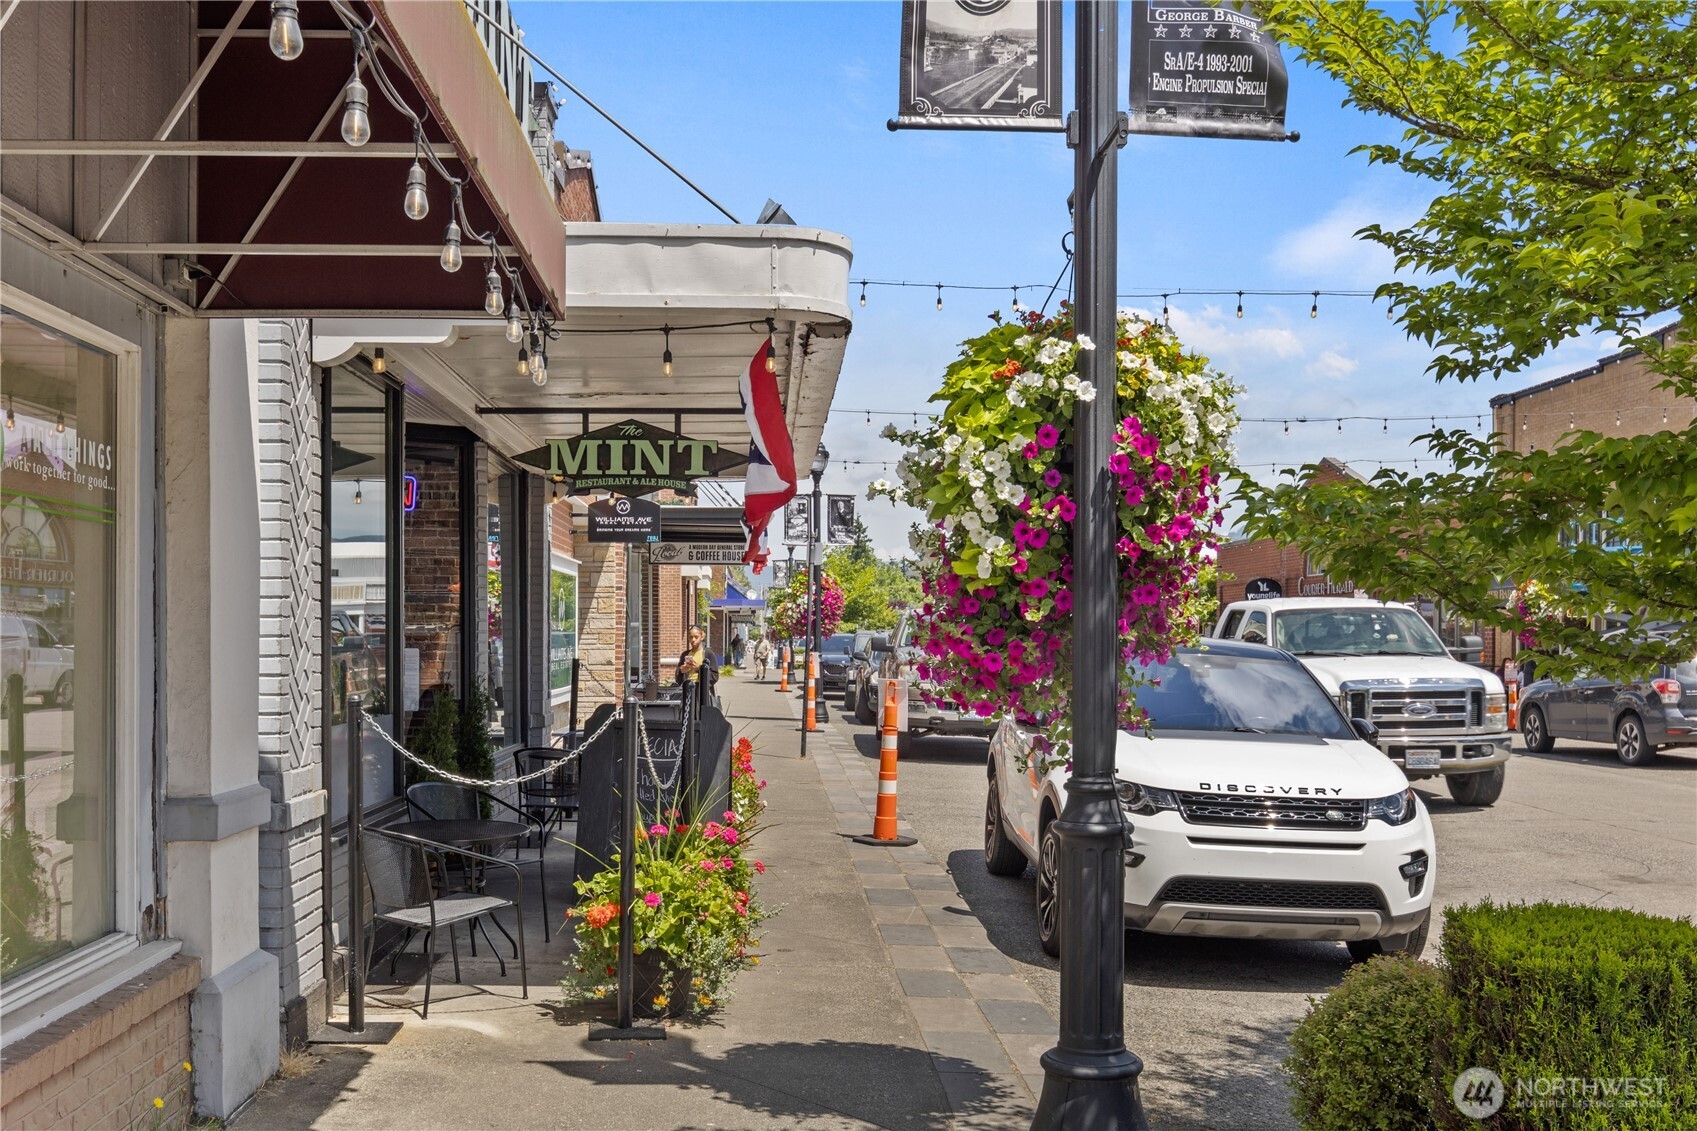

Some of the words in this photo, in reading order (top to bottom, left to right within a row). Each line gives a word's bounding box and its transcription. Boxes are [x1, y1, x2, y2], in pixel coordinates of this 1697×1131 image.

[1155, 9, 1209, 21] GEORGE
[1214, 9, 1258, 30] BARBER
[1206, 54, 1253, 73] 1993-2001
[1152, 72, 1183, 92] ENGINE
[1185, 74, 1234, 94] PROPULSION
[618, 424, 645, 437] The
[545, 439, 718, 476] MINT
[32, 461, 71, 481] together
[73, 468, 86, 484] for
[575, 477, 631, 488] RESTAURANT
[640, 477, 657, 486] ALE
[658, 478, 687, 489] HOUSE
[688, 551, 694, 561] &
[695, 551, 720, 561] COFFEE
[1199, 782, 1343, 796] DISCOVERY
